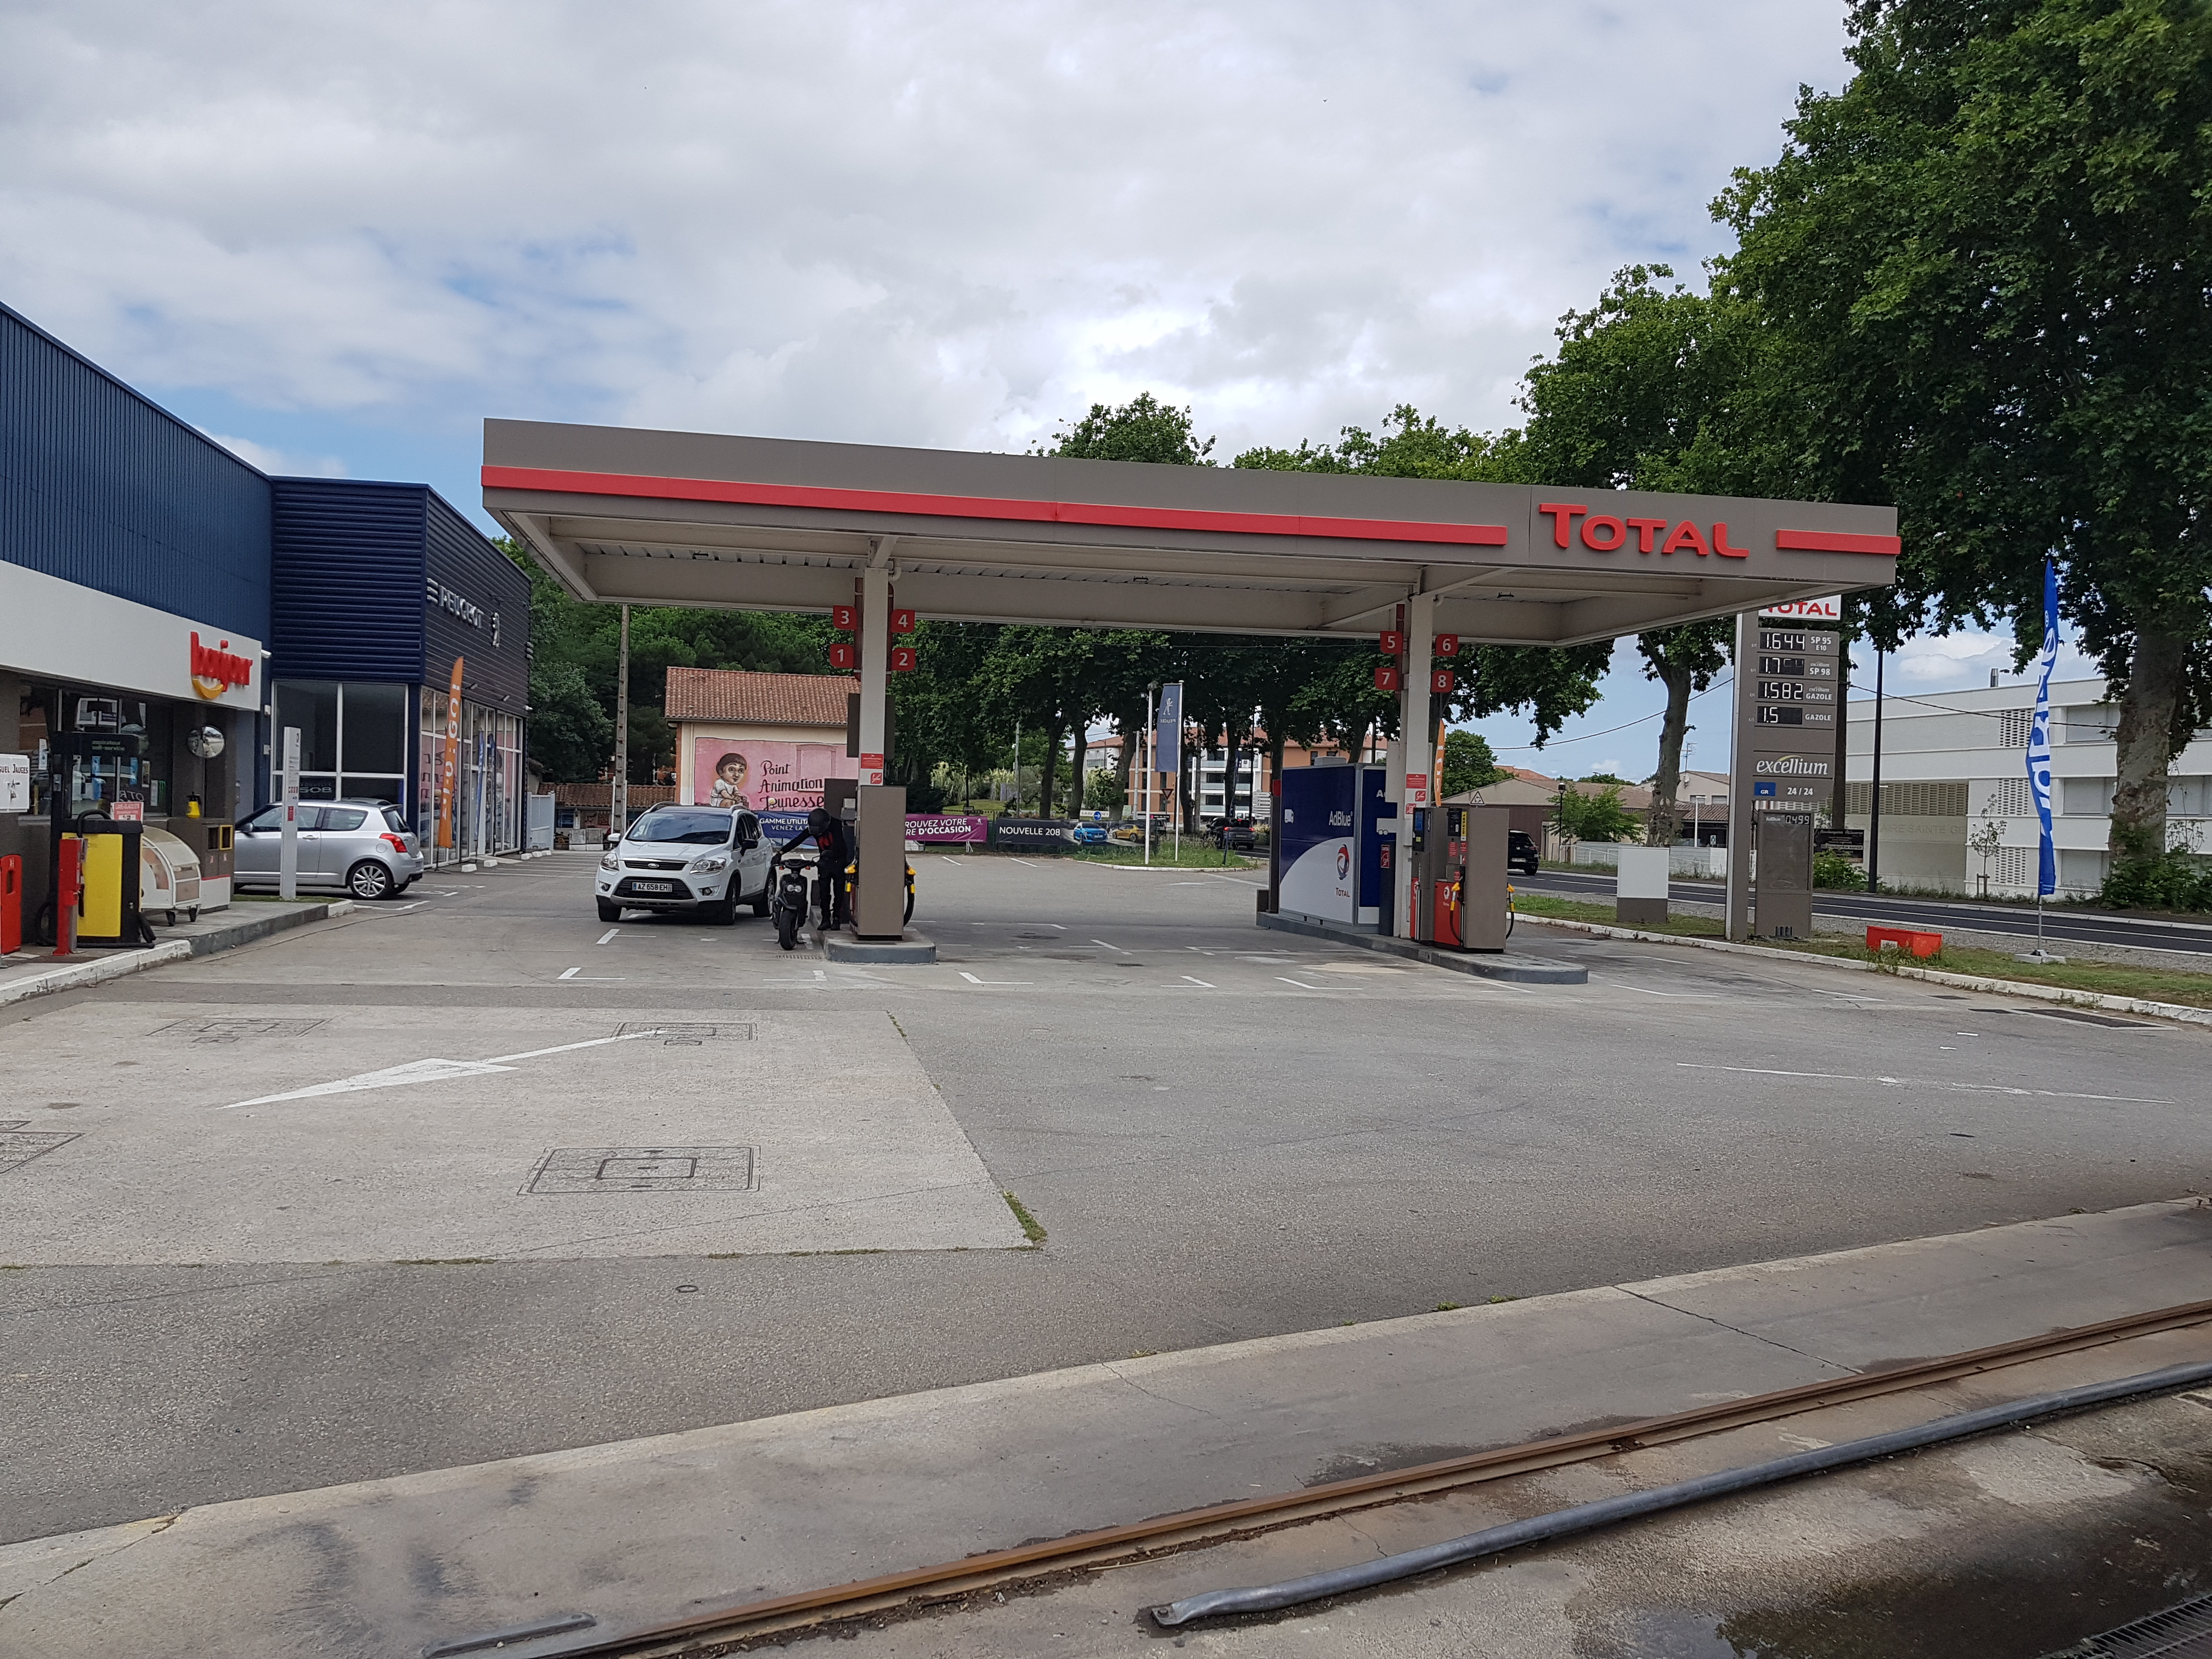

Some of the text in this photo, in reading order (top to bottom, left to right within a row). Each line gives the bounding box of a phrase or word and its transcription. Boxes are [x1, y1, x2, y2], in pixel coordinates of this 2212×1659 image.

[1538, 503, 1750, 558] TOTAL
[1768, 601, 1837, 616] OTAL
[840, 610, 849, 624] 3
[898, 614, 909, 628] 4
[1387, 635, 1396, 649] 5
[1442, 638, 1451, 652] 6
[1767, 633, 1805, 650] 1.644
[837, 648, 844, 663] 1
[899, 652, 909, 666] 2
[1382, 672, 1390, 685] 7
[1437, 675, 1447, 688] 8
[1764, 682, 1803, 699] 1.582
[760, 760, 791, 776] Point
[1756, 758, 1827, 775] excellium
[758, 779, 823, 794] Animation
[759, 795, 825, 811] Jeunesse
[940, 818, 968, 826] VOTRE
[918, 825, 971, 835] D'OCCASION
[999, 826, 1060, 836] NOUVELLE 208
